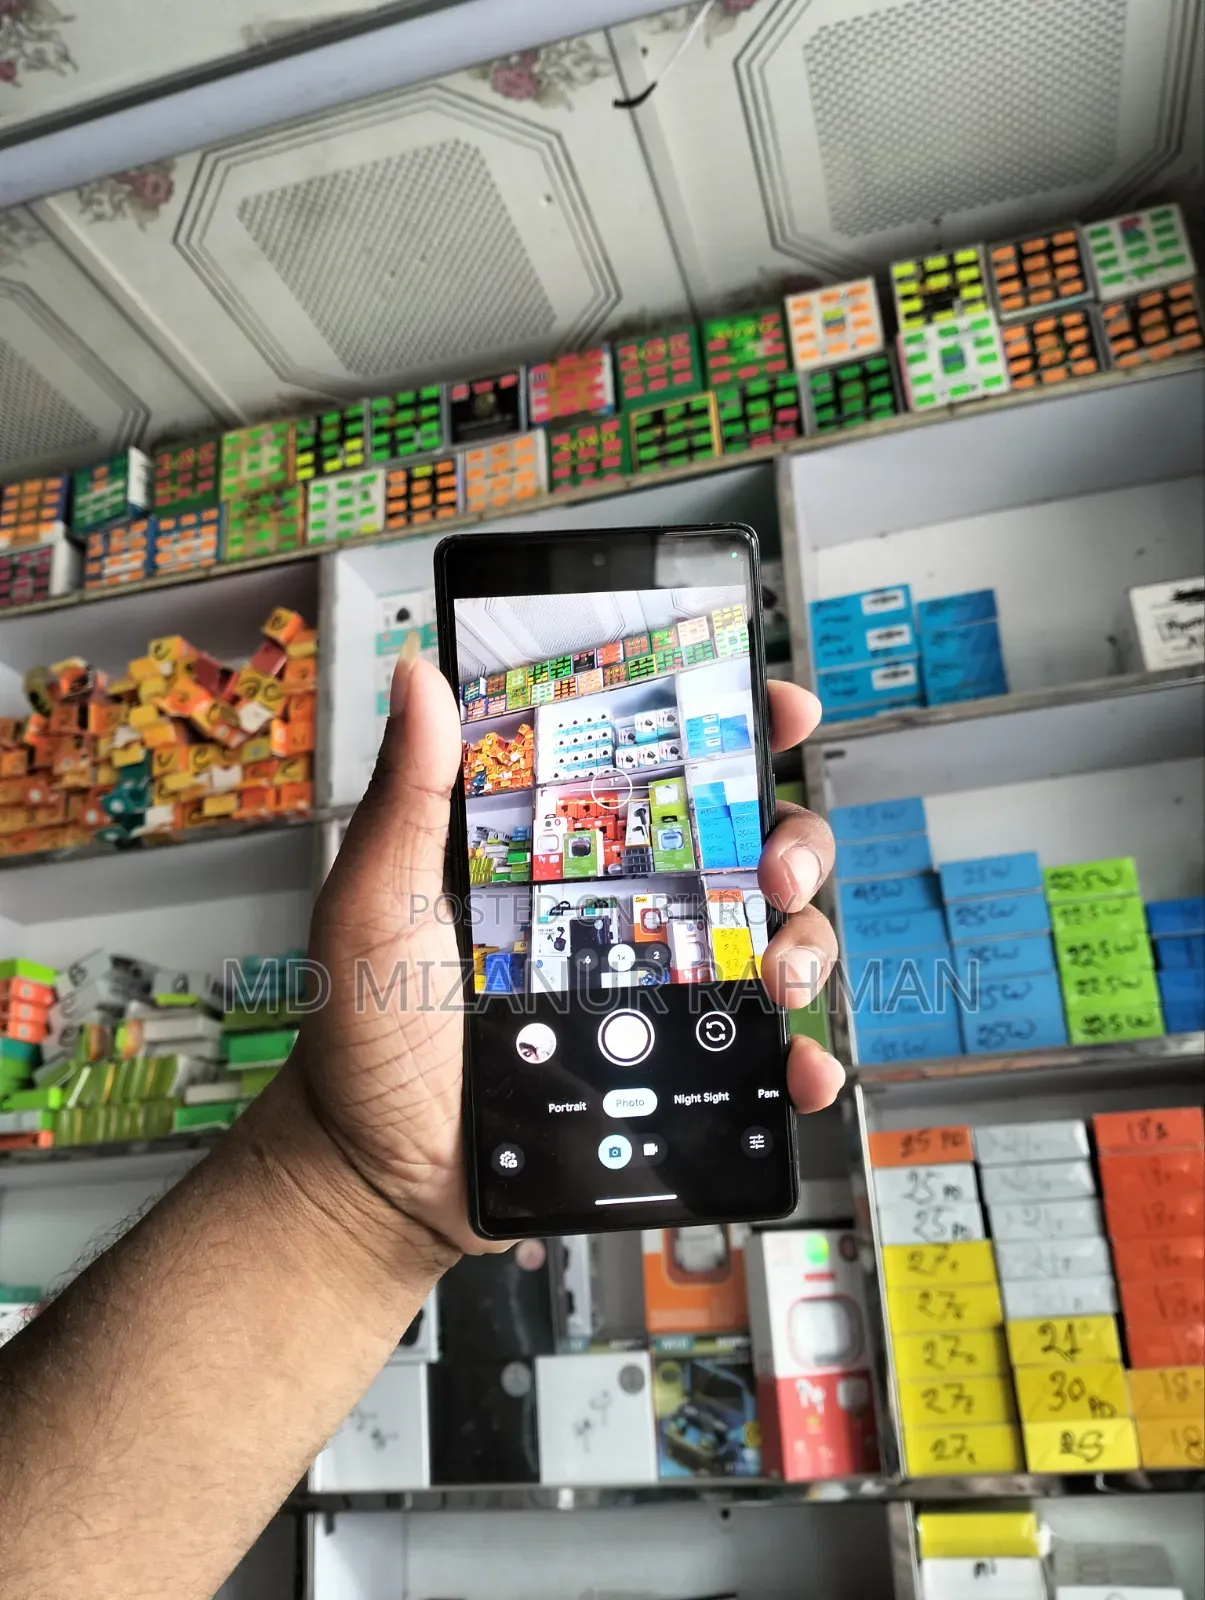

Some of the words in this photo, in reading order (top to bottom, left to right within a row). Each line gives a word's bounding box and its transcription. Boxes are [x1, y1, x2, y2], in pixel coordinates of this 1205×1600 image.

[653, 951, 660, 960] 2
[616, 1098, 645, 1108] Photo
[674, 1094, 701, 1105] Night
[703, 1091, 730, 1103] Sight
[548, 1101, 587, 1113] Portrait
[1048, 1370, 1086, 1412] 30
